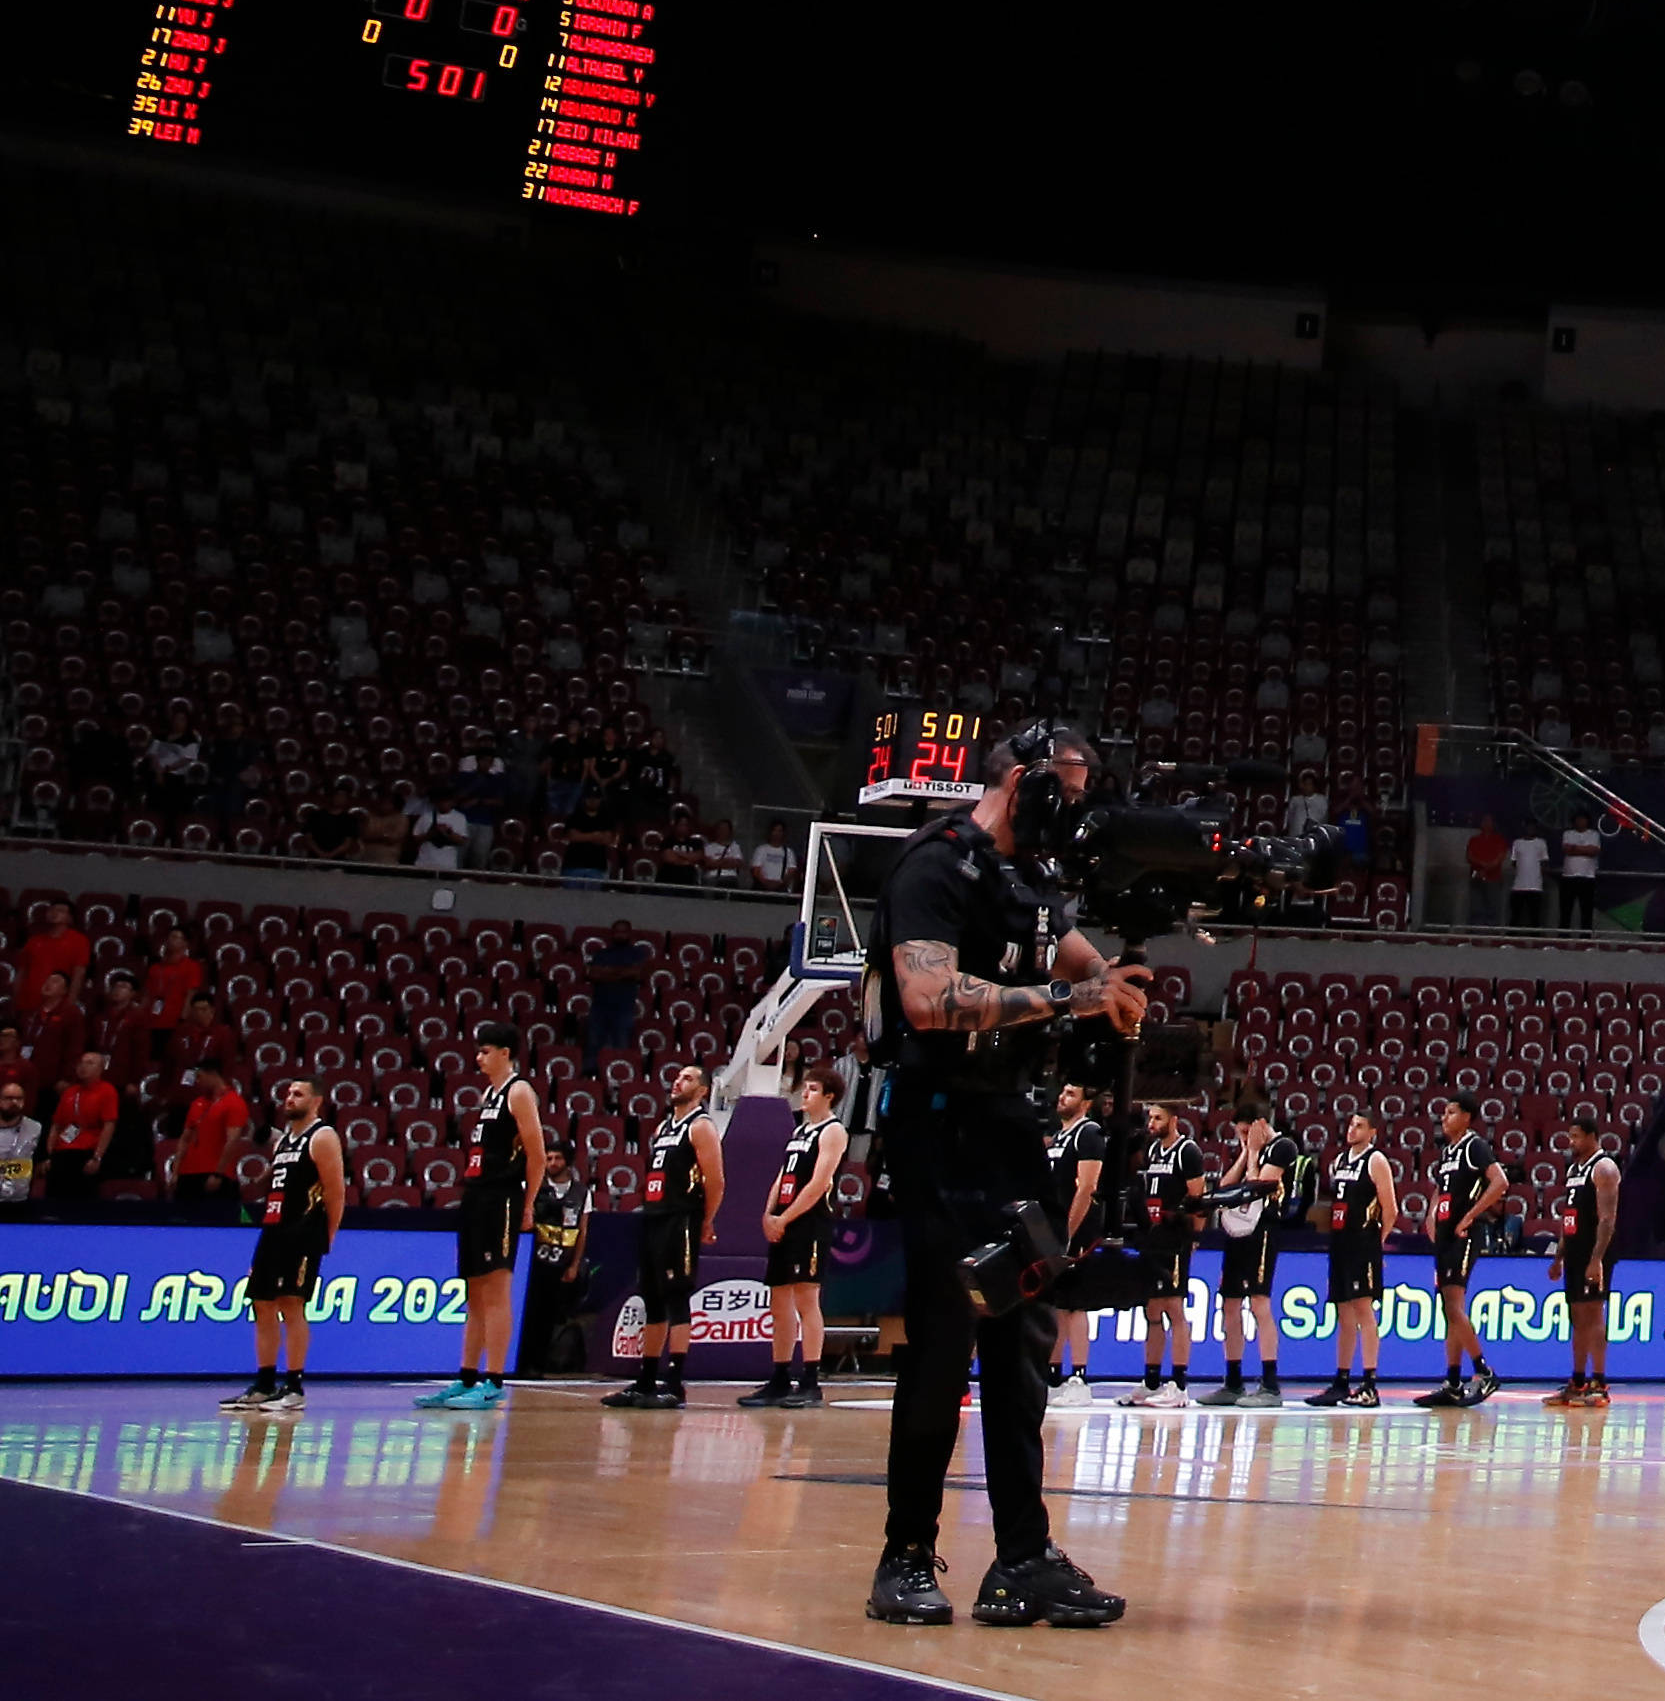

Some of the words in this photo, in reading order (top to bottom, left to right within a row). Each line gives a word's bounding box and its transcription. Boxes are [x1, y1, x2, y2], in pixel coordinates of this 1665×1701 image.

[156, 4, 176, 21] 11
[491, 5, 519, 37] 0
[560, 10, 571, 27] 5
[152, 27, 171, 44] 17
[362, 19, 382, 43] 0
[560, 32, 568, 47] 7
[141, 48, 168, 67] 21
[499, 44, 518, 69] 0
[548, 53, 565, 69] 11
[137, 71, 161, 90] 26
[544, 75, 561, 91] 12
[132, 94, 158, 113] 35
[541, 97, 558, 112] 14
[128, 117, 154, 136] 39
[537, 118, 555, 134] 17
[528, 139, 551, 157] 21
[524, 161, 548, 179] 22
[522, 182, 545, 200] 31
[867, 745, 891, 786] 24
[911, 742, 967, 782] 24
[926, 782, 972, 793] TISSOT
[1337, 1182, 1346, 1199] 5
[0, 1270, 129, 1322] AUDI
[369, 1277, 467, 1323] 202
